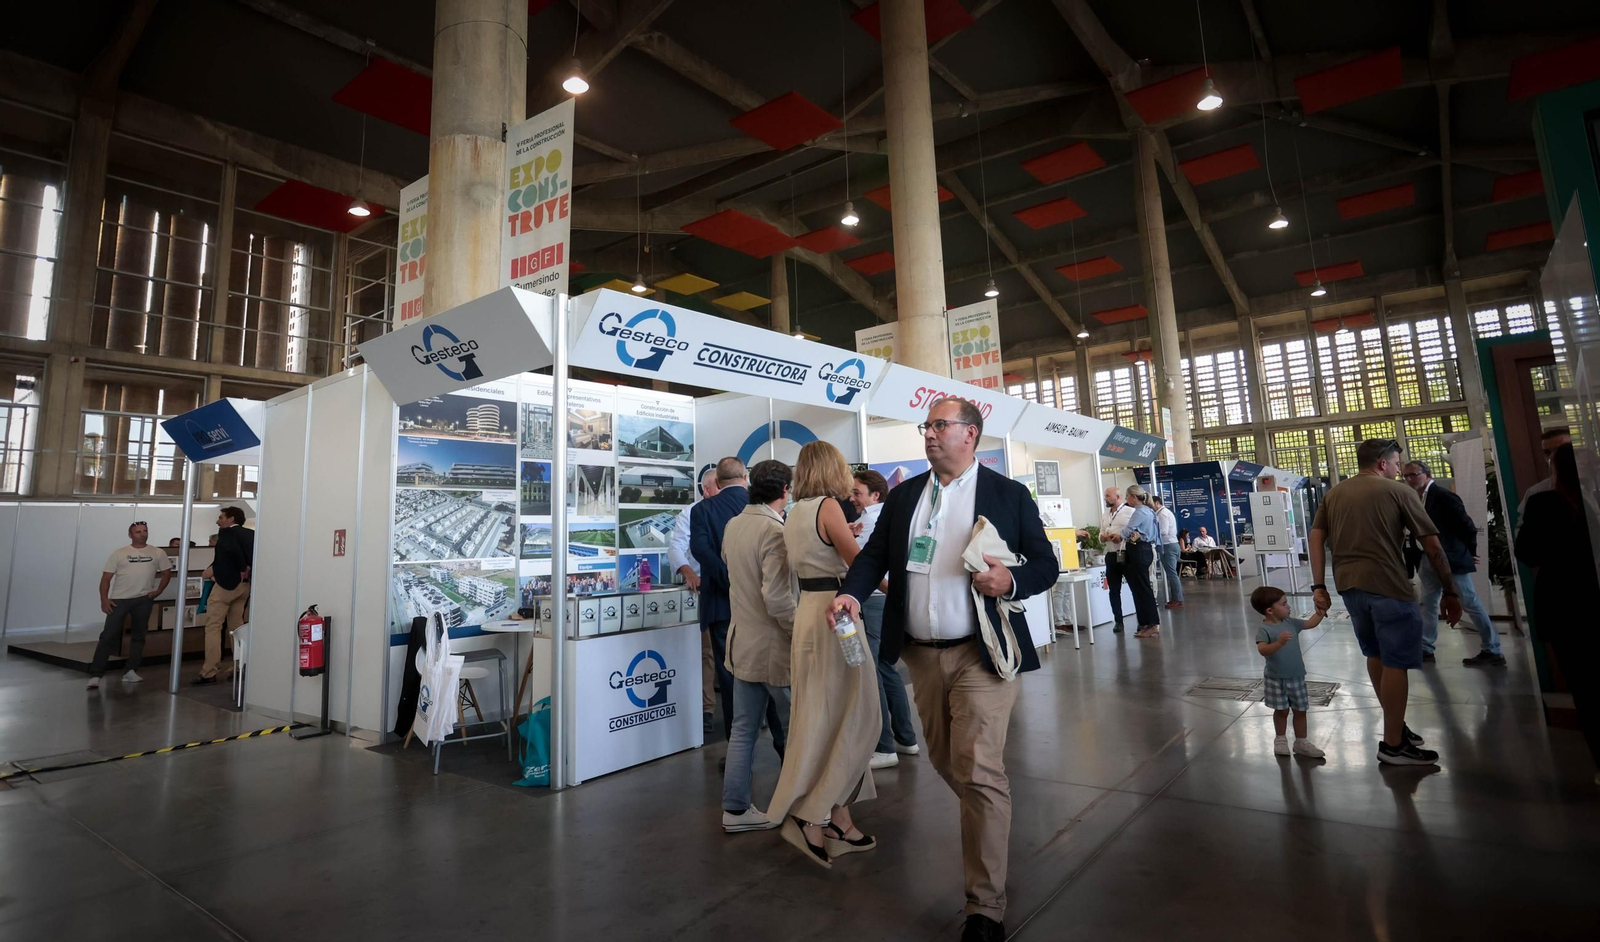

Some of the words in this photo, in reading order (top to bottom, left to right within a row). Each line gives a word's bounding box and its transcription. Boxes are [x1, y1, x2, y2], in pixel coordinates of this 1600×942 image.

[521, 137, 534, 147] FERIA
[534, 121, 565, 140] PROFESIONAL
[530, 129, 566, 151] CONSTRUCCIÓN
[509, 149, 562, 190] EXPO
[508, 193, 570, 237] TRUYE
[599, 312, 689, 352] Gesteco
[952, 325, 991, 345] EXPO
[411, 339, 479, 365] Gesteco
[697, 347, 808, 382] CONSTRUCTORA
[954, 349, 1000, 370] TRUYE
[818, 362, 872, 390] Gesteco
[464, 386, 505, 396] esidenciales
[609, 668, 676, 690] Gesteco
[609, 705, 677, 730] CONSTRUCTORA
